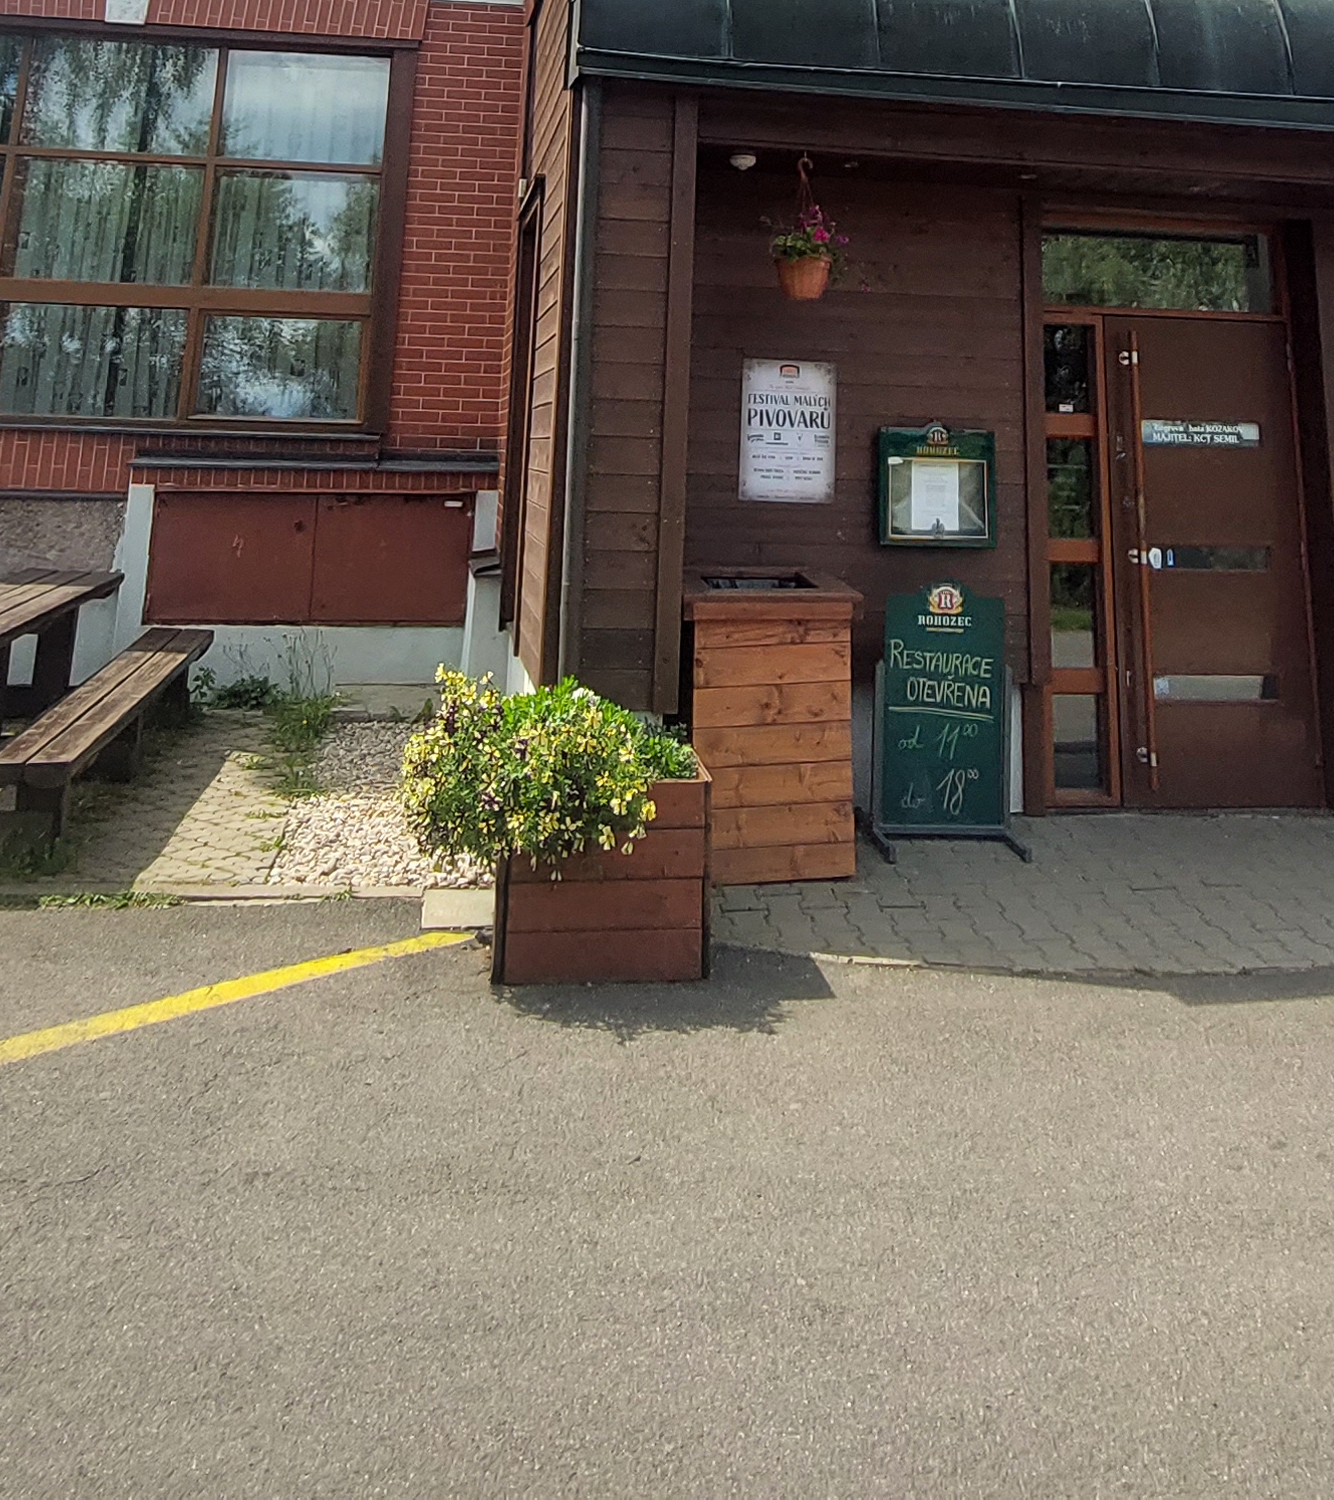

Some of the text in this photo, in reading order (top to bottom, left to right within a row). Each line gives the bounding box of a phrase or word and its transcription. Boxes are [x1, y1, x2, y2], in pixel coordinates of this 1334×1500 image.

[747, 393, 831, 408] FESTIVAL MALÝCH
[747, 407, 831, 429] PIVOVARŮ
[917, 614, 972, 627] ROHOZEC
[890, 639, 994, 678] RESTAURACE
[906, 675, 991, 709] OTEVŘENA
